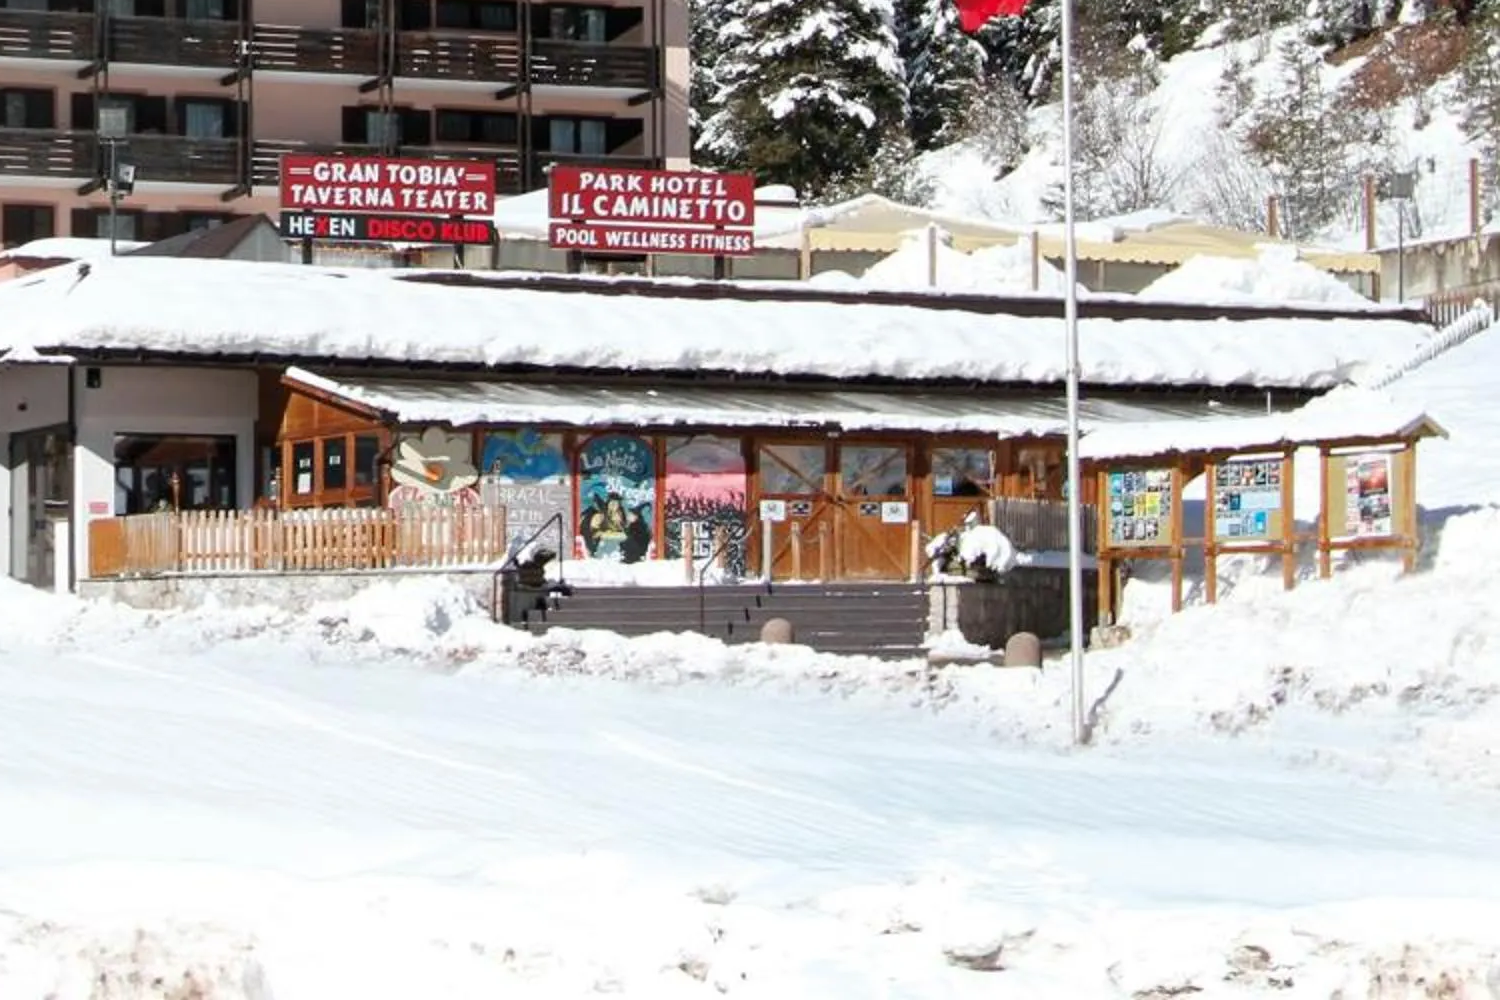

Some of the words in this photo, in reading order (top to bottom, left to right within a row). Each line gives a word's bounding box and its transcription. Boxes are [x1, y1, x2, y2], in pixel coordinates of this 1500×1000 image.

[314, 162, 379, 183] GRAN
[580, 172, 644, 193] PARK
[651, 176, 727, 196] HOTEL
[290, 184, 395, 207] TAVERNA
[400, 189, 488, 211] TEATER
[561, 193, 585, 215] IL
[593, 194, 746, 222] CAMINETTO
[289, 216, 356, 236] HEXEN
[368, 219, 436, 238] DISCO
[442, 222, 489, 241] KLUB
[555, 227, 598, 245] POOL
[605, 231, 686, 249] WELLNESS
[691, 234, 750, 251] FITNESS
